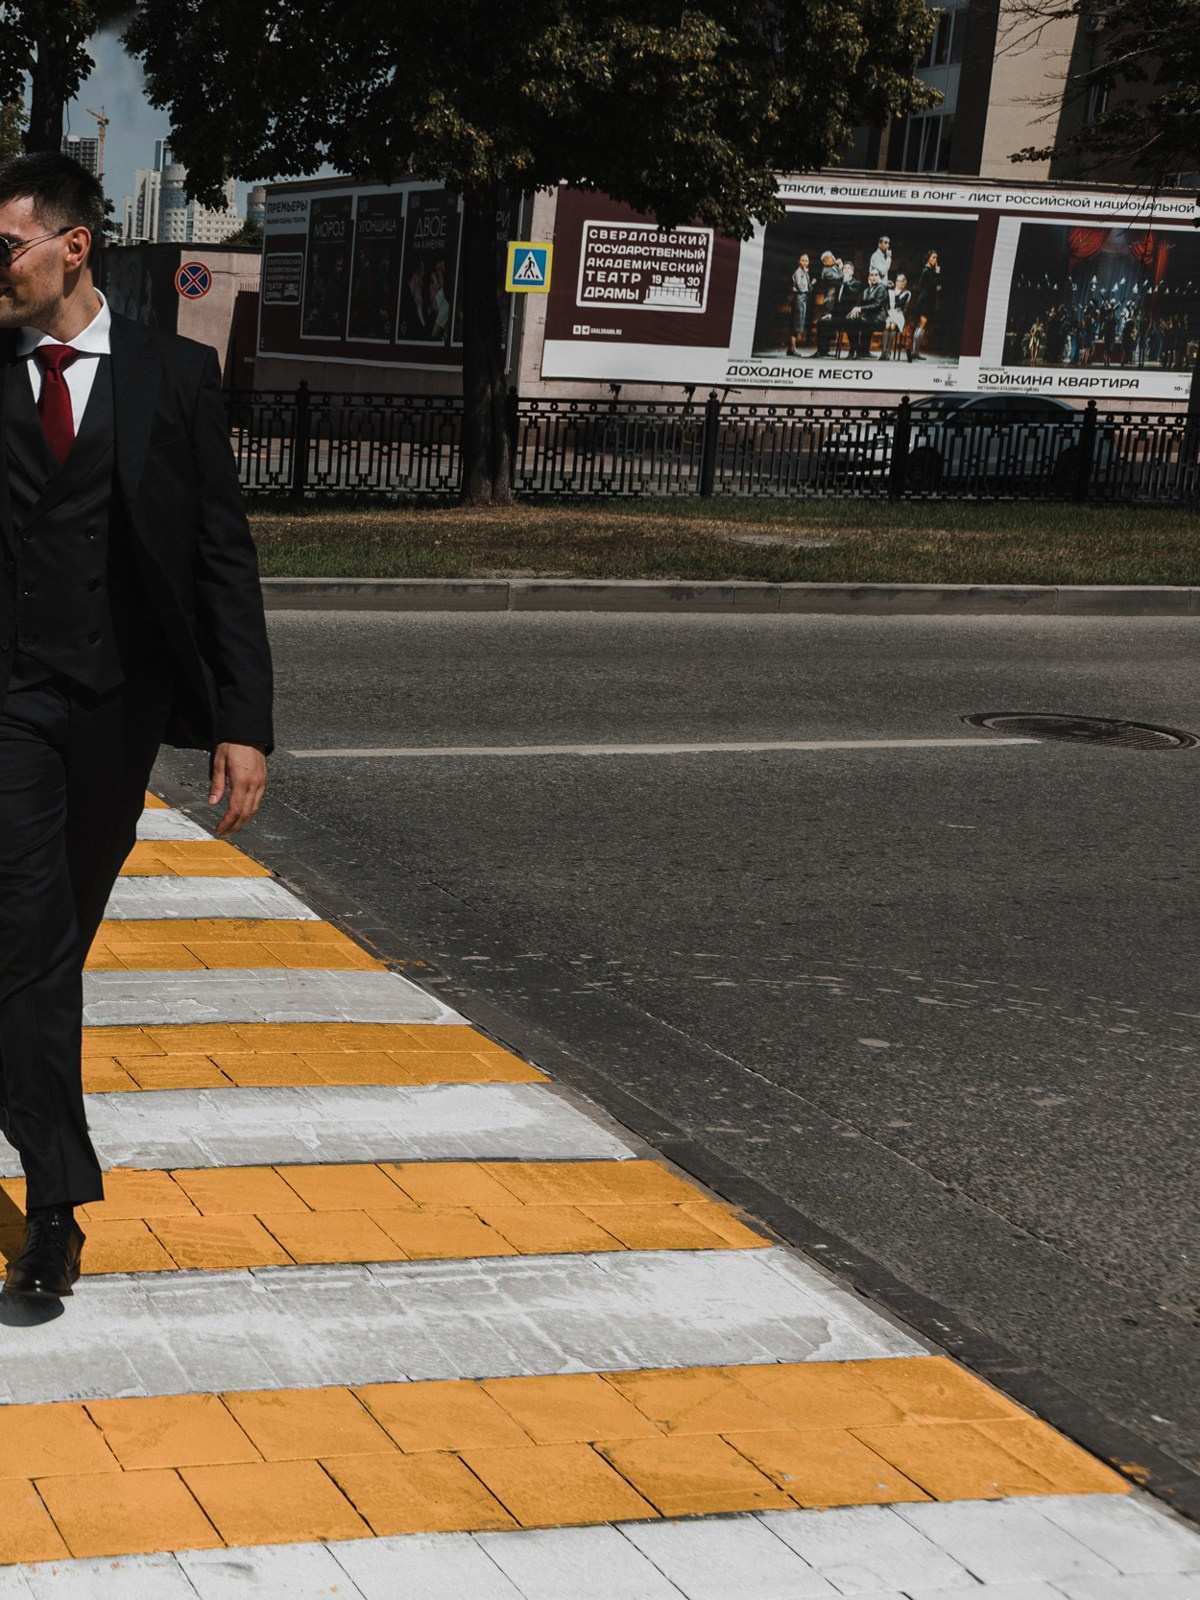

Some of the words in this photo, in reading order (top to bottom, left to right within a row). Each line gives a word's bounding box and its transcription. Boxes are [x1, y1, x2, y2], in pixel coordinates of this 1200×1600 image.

[267, 200, 307, 213] ПРЕМЬЕРЫ
[830, 186, 907, 198] ВОШЕДШИЕ
[911, 190, 919, 199] В
[922, 190, 957, 201] ЛОНГ
[968, 193, 1002, 203] ЛИСТ
[1005, 195, 1091, 208] РОССИЙСКОЙ
[1094, 200, 1195, 213] НАЦИОНАЛЬНОЙ
[314, 220, 345, 238] МОРОЗ
[358, 219, 397, 233] УГОНЩИЦА
[414, 215, 448, 239] ДВОЕ
[589, 229, 707, 246] СВЕРДЛОВСКИЙ
[588, 243, 706, 259] ГОСУДАРСТВЕННЫЙ
[586, 257, 705, 274] АКАДЕМИЧЕСКИЙ
[586, 270, 642, 284] ТЕАТР
[651, 274, 663, 285] 19
[686, 276, 701, 287] 30
[584, 286, 639, 300] ДРАМЫ
[726, 365, 814, 379] ДОХОДНОЕ
[818, 368, 874, 381] МЕСТО
[978, 371, 1054, 387] ЗОЙКИНА
[1057, 376, 1140, 390] КВАРТИРА
